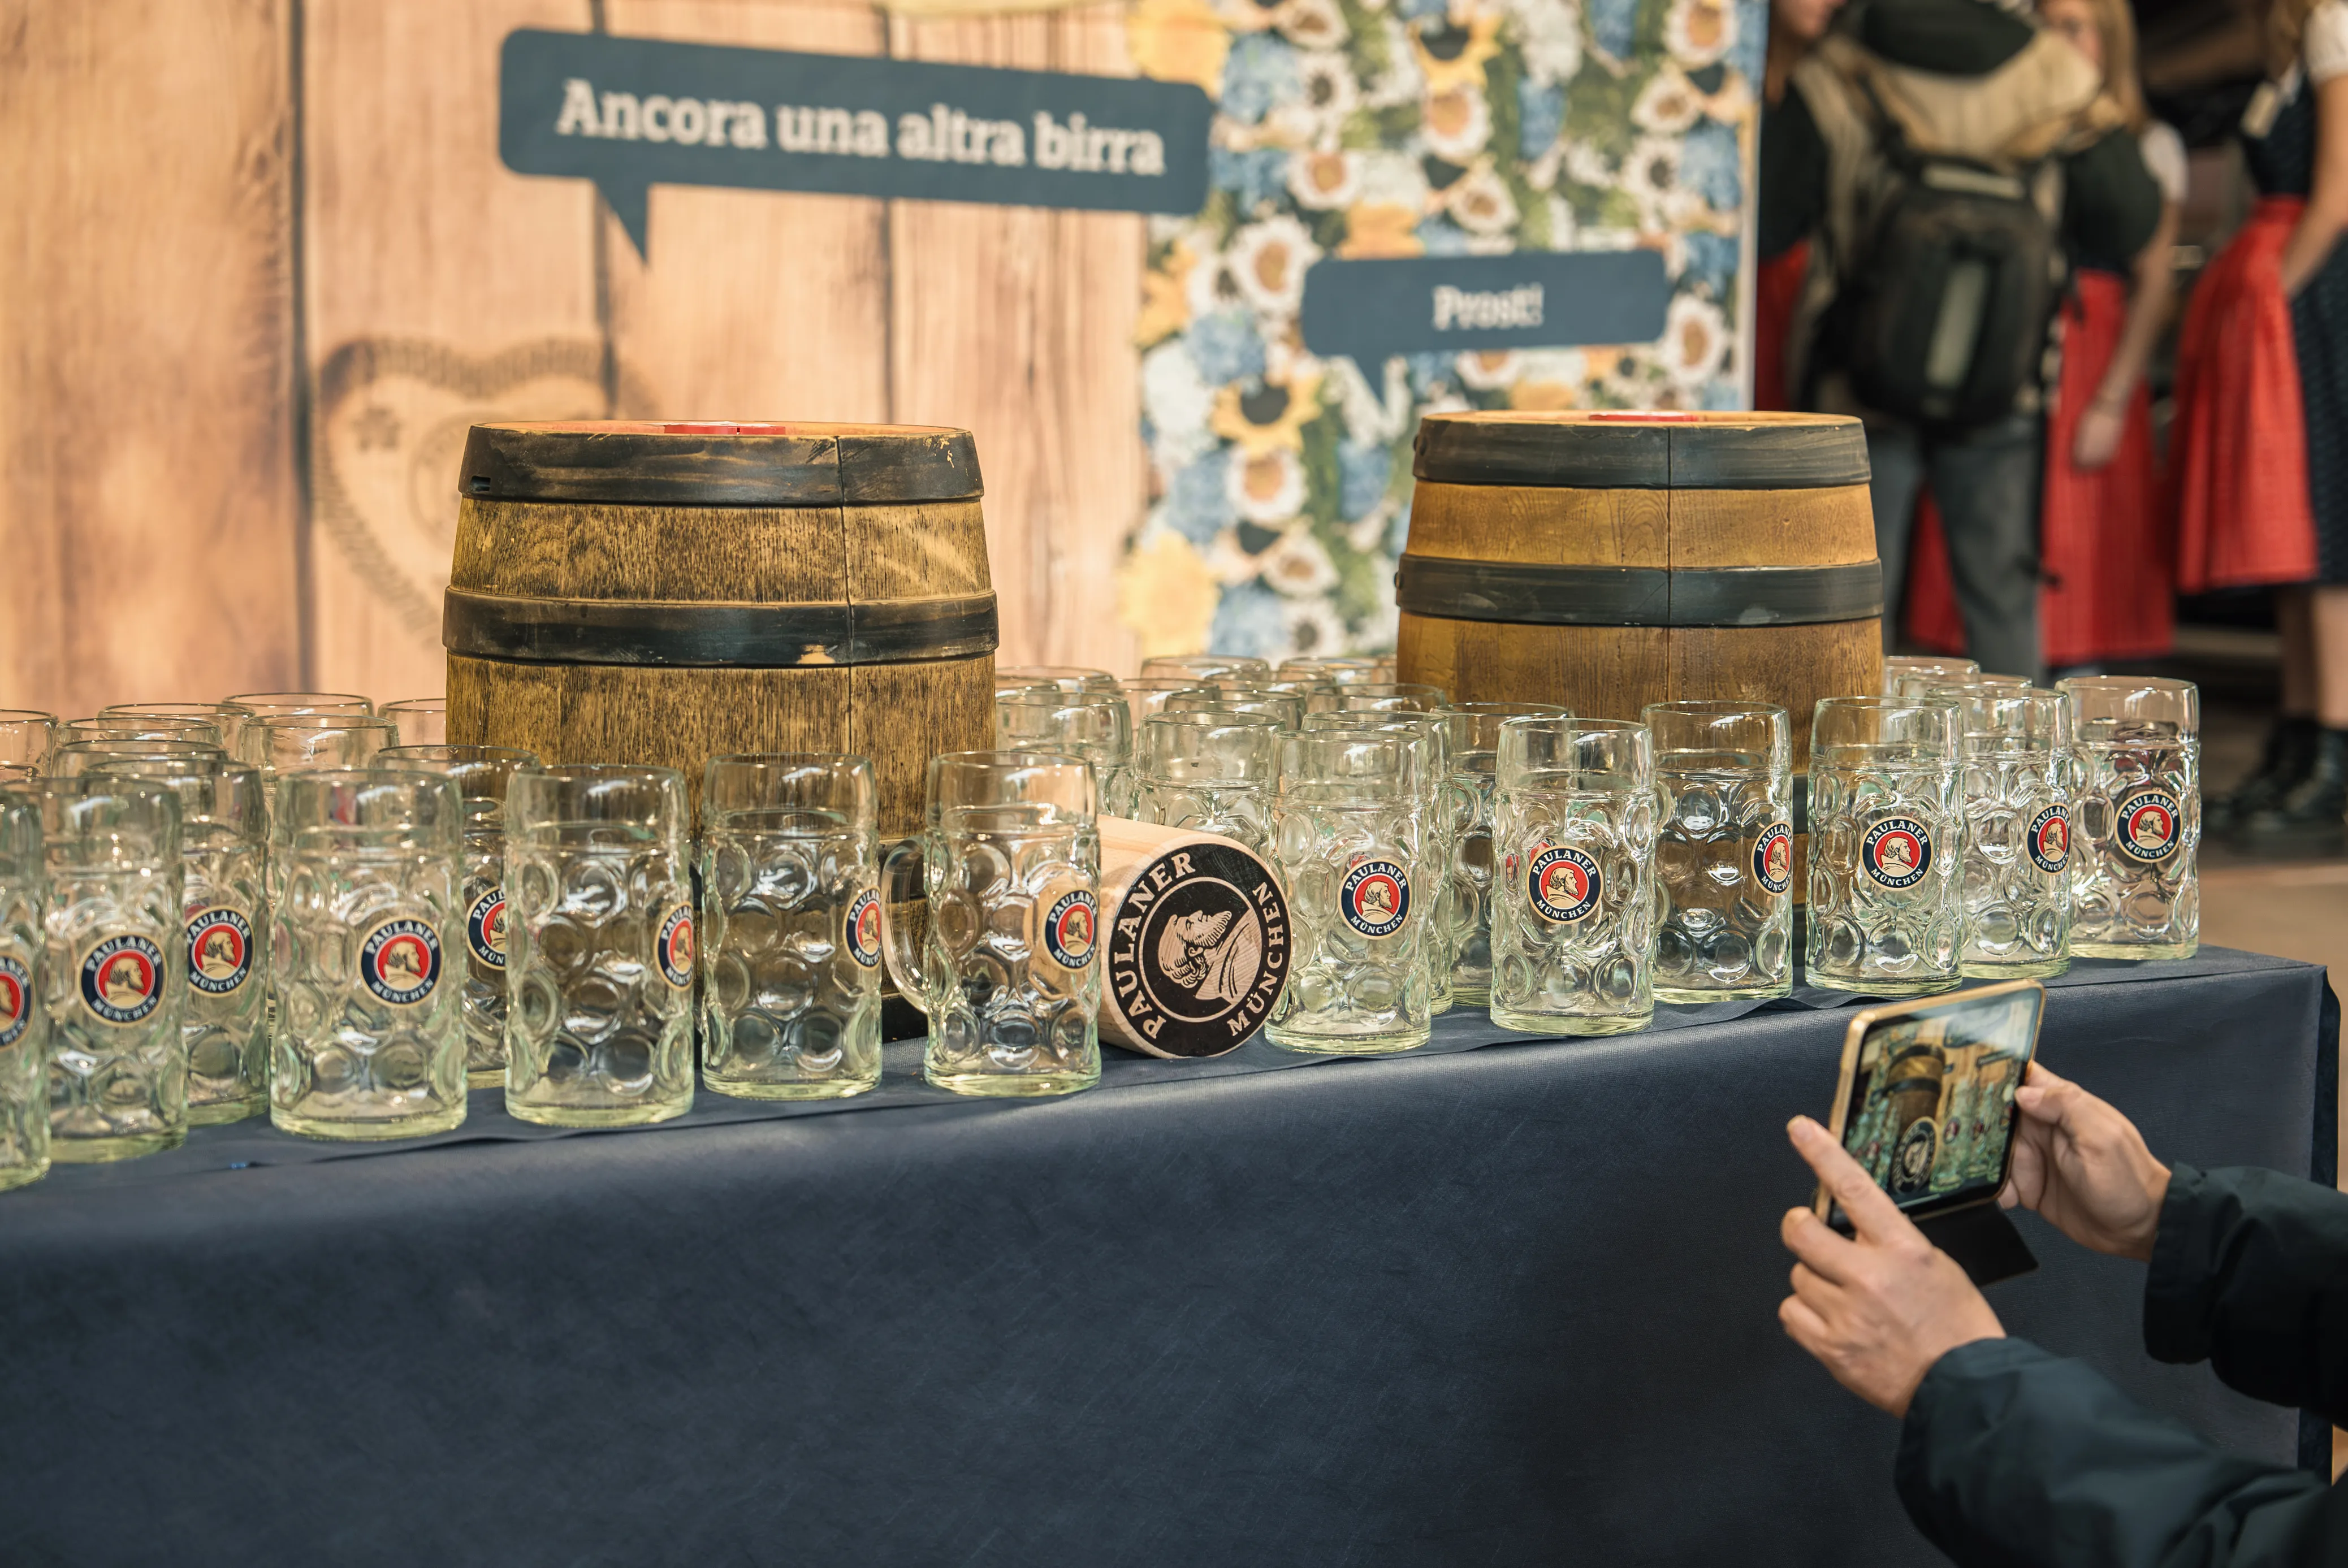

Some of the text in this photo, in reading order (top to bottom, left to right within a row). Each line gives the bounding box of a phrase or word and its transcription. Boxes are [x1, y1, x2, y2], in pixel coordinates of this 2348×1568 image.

[556, 78, 1166, 176] Ancora una altra birra
[1433, 284, 1544, 330] Prost!
[2031, 807, 2071, 833] PAULANER
[2121, 794, 2178, 820] PAULANER
[1866, 820, 1928, 845] PAULANER
[2035, 852, 2069, 870] MÜNCHEN
[2126, 840, 2174, 858] MÜNCHEN
[1345, 863, 1407, 891] PAULANER
[1532, 850, 1597, 877] PAULANER
[1871, 868, 1923, 886] MÜNCHEN
[472, 890, 505, 920] PAUL
[1049, 891, 1097, 923] PAULANER
[1537, 899, 1591, 919] MÜNCHEN
[1351, 914, 1403, 934] MÜNCHEN
[365, 921, 438, 955] PAULANER
[1114, 852, 1195, 1039] PAULANER
[85, 935, 161, 971] PAULANER
[1226, 882, 1284, 1037] MÜNCHEN
